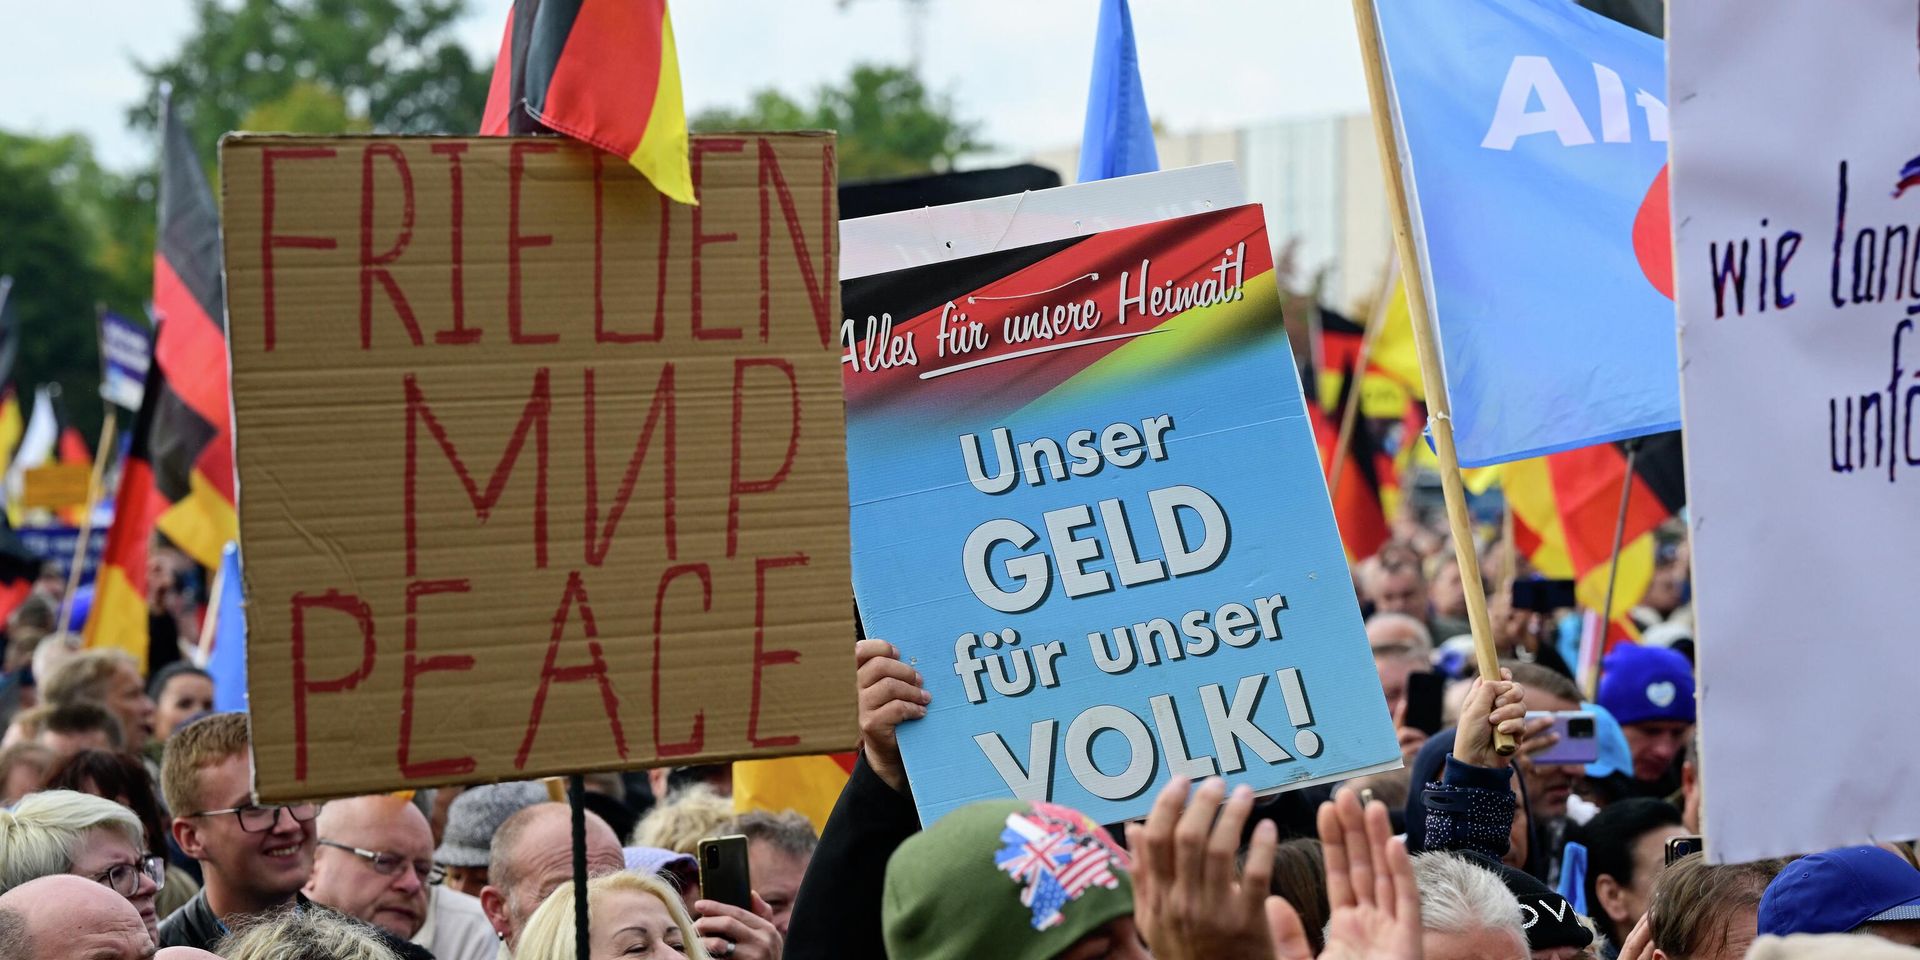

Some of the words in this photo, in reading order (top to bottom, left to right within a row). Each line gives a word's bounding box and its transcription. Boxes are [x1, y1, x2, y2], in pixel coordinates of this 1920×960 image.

[262, 139, 833, 352] FRIEDEN
[841, 311, 918, 373] Alles
[936, 300, 989, 358] für
[1003, 299, 1101, 345] unsere
[1118, 241, 1246, 324] Heimat!
[1710, 218, 1802, 320] wie
[401, 359, 803, 577] МИР
[959, 413, 1174, 494] Unser
[961, 484, 1232, 614] GELD
[291, 552, 810, 782] PEACE
[953, 627, 1067, 704] für
[1087, 593, 1288, 675] unser
[971, 666, 1324, 804] VOLK!
